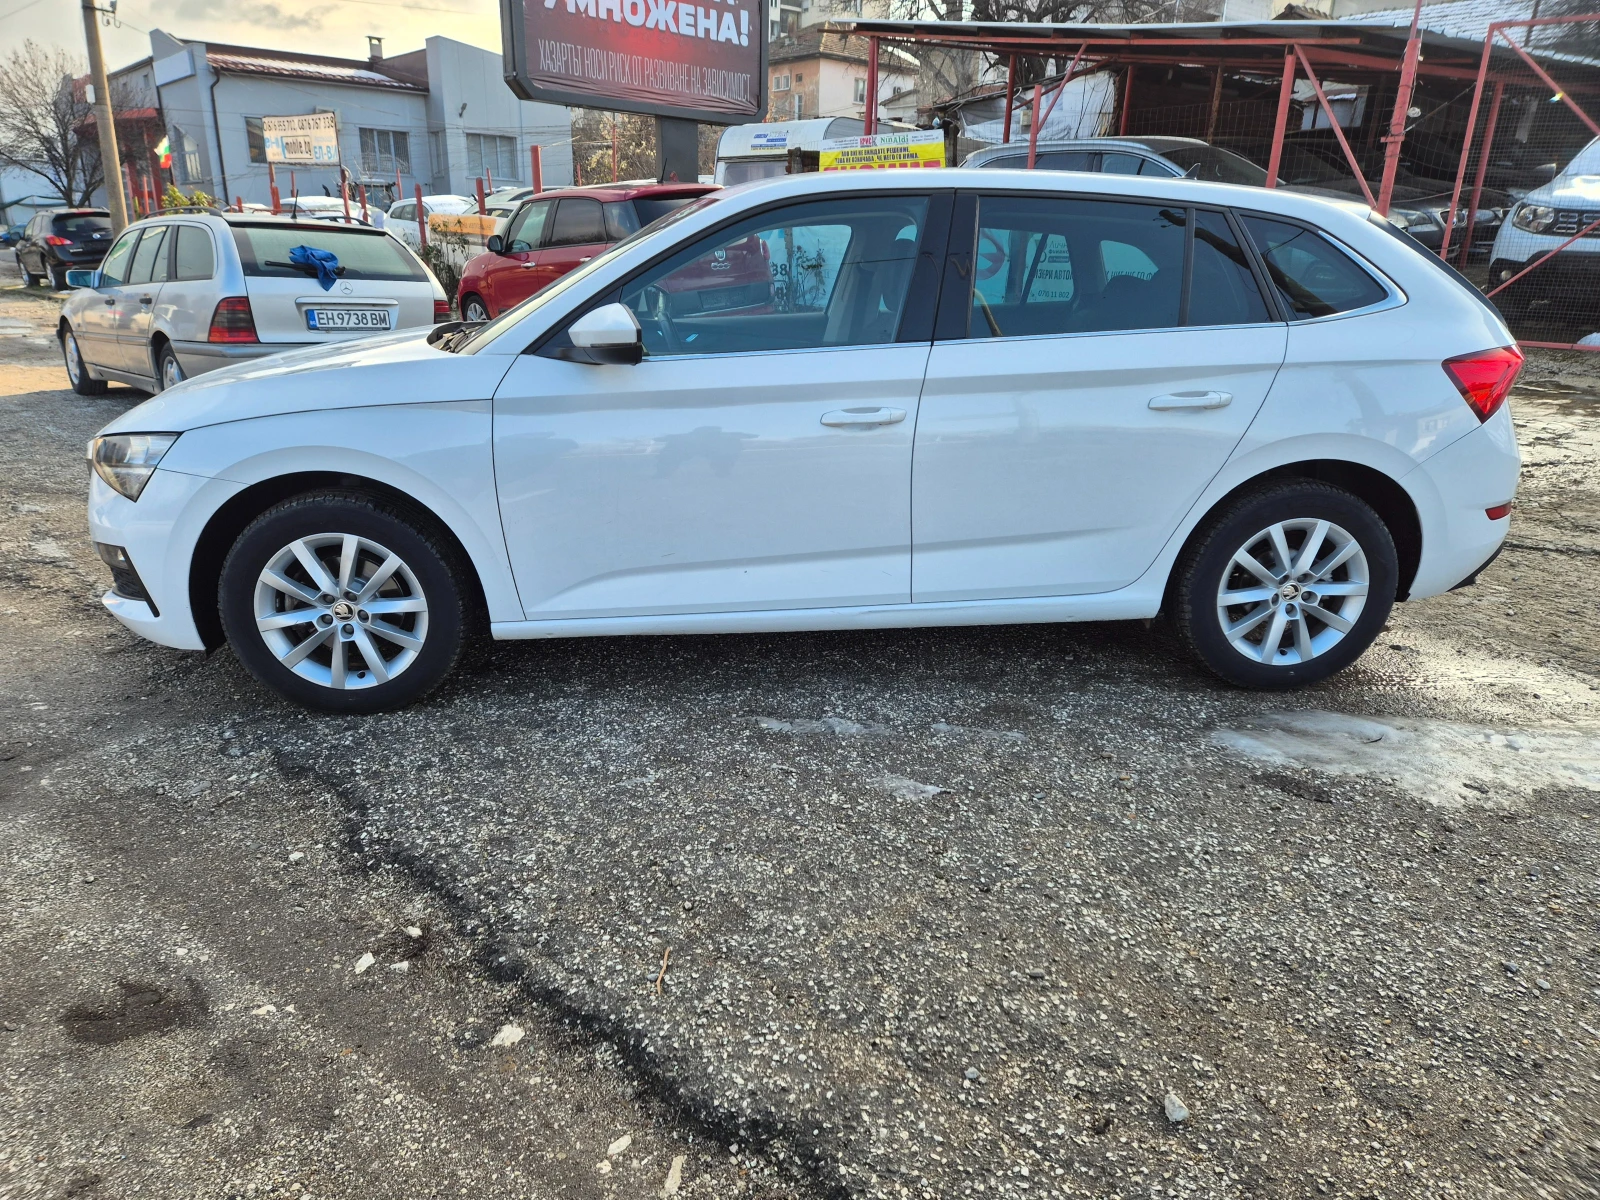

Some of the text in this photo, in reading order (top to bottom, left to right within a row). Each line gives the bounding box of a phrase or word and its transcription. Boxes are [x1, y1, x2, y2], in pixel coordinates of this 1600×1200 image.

[544, 0, 749, 47] НОЖЕНА!
[538, 38, 751, 102] ХАЗАРТЪТ НОСИ РИСК ОТ РАЗВИВАНЕ НА ЗАВИСИМОСТ
[370, 312, 388, 326] BM
